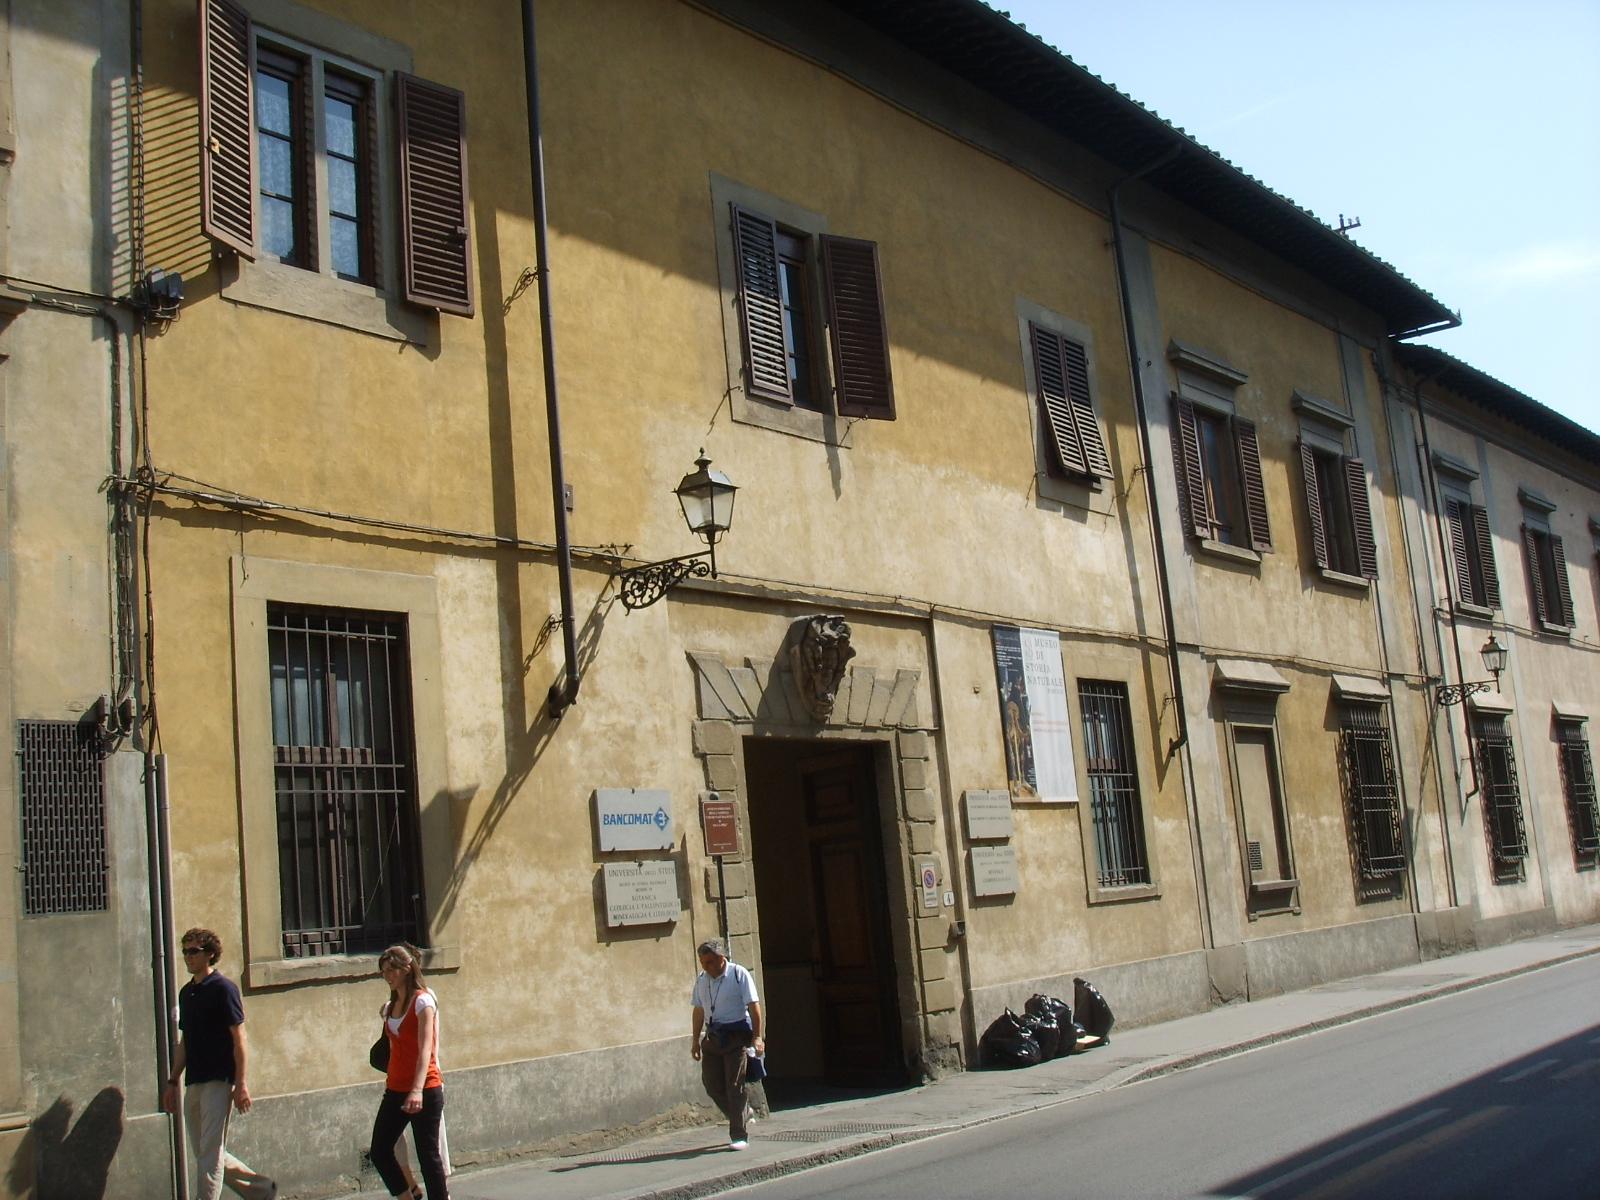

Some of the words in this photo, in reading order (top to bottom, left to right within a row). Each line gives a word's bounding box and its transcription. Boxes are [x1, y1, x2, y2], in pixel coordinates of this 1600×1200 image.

[1034, 637, 1057, 649] MUSEO
[1027, 675, 1064, 687] NATURALE
[603, 813, 653, 825] BANCOMAT
